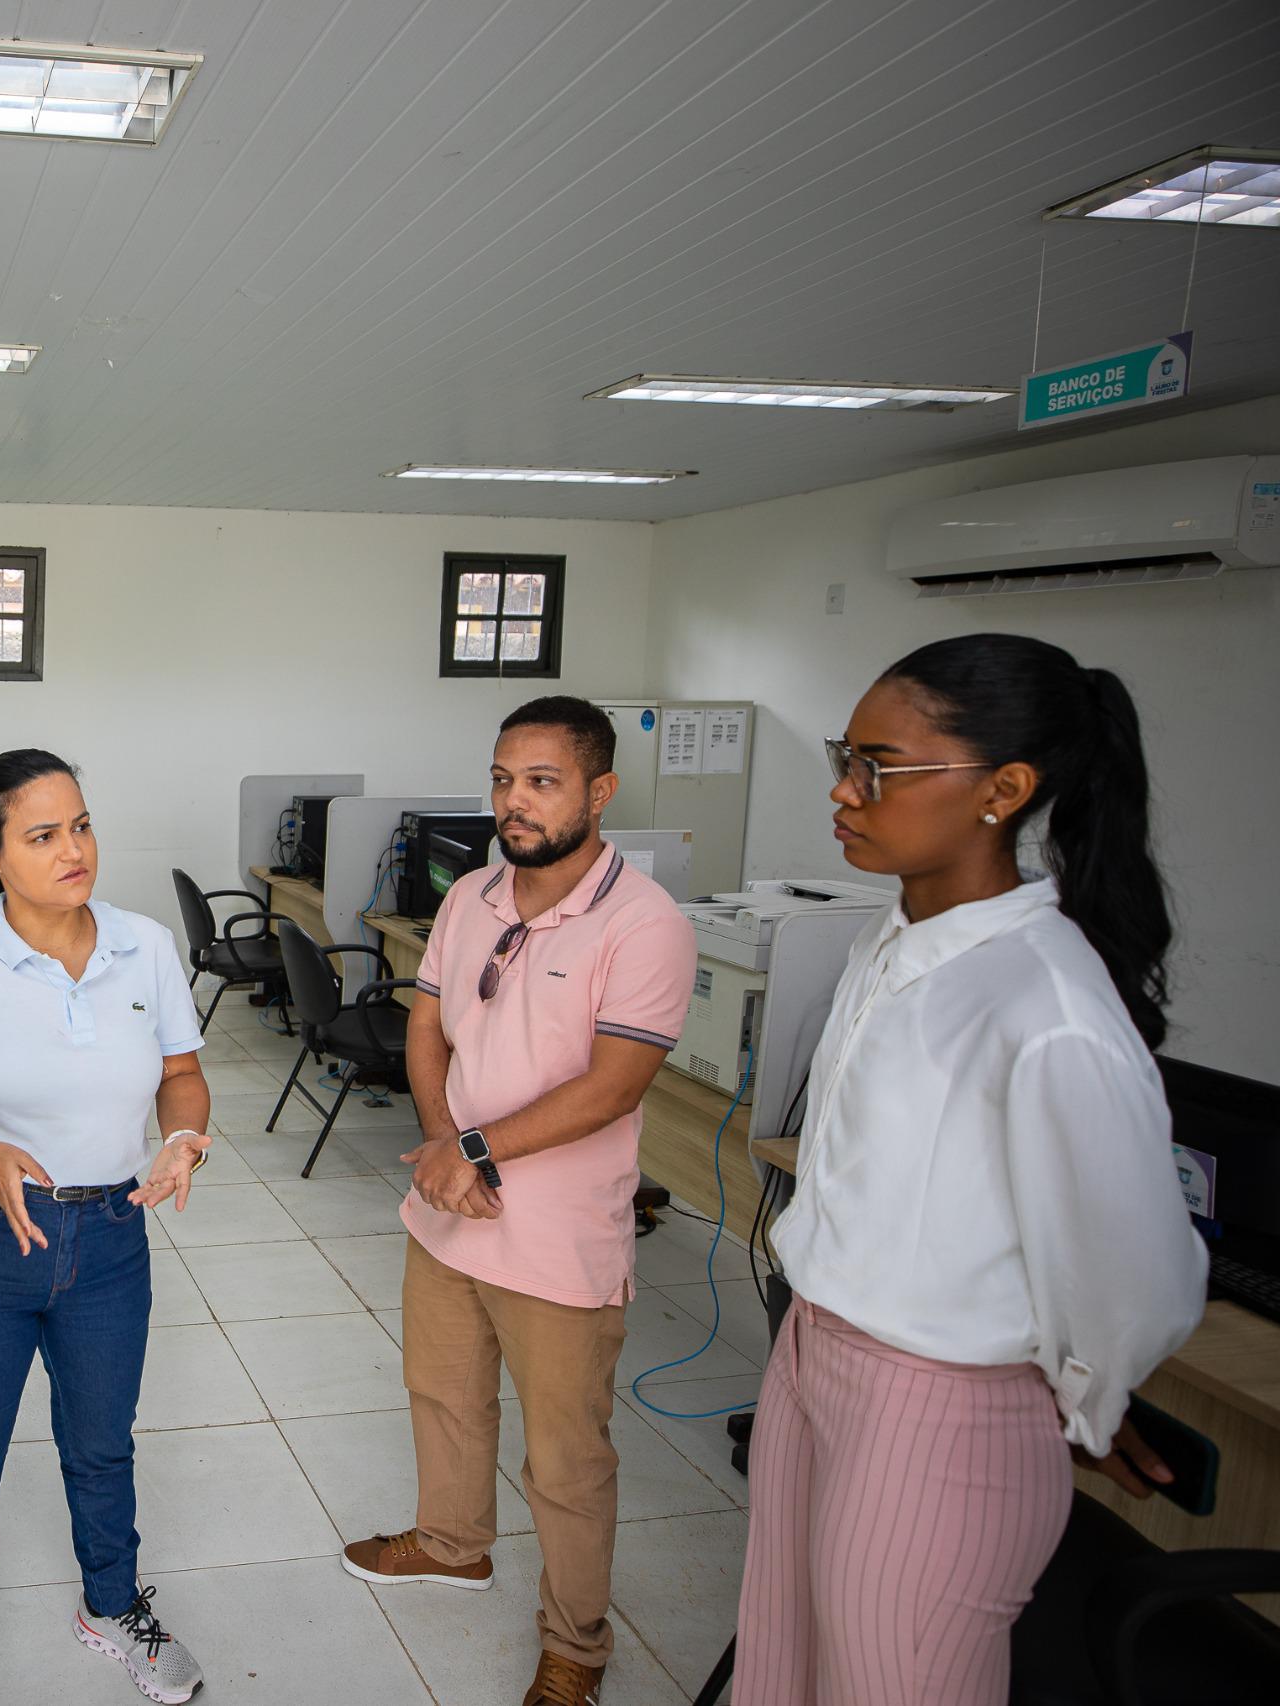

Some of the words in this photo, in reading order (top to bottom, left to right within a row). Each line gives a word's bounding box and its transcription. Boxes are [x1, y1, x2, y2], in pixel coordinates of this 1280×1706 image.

[1048, 372, 1100, 397] BANCO
[1104, 365, 1126, 383] DE
[1047, 383, 1124, 412] SERVIÇOS
